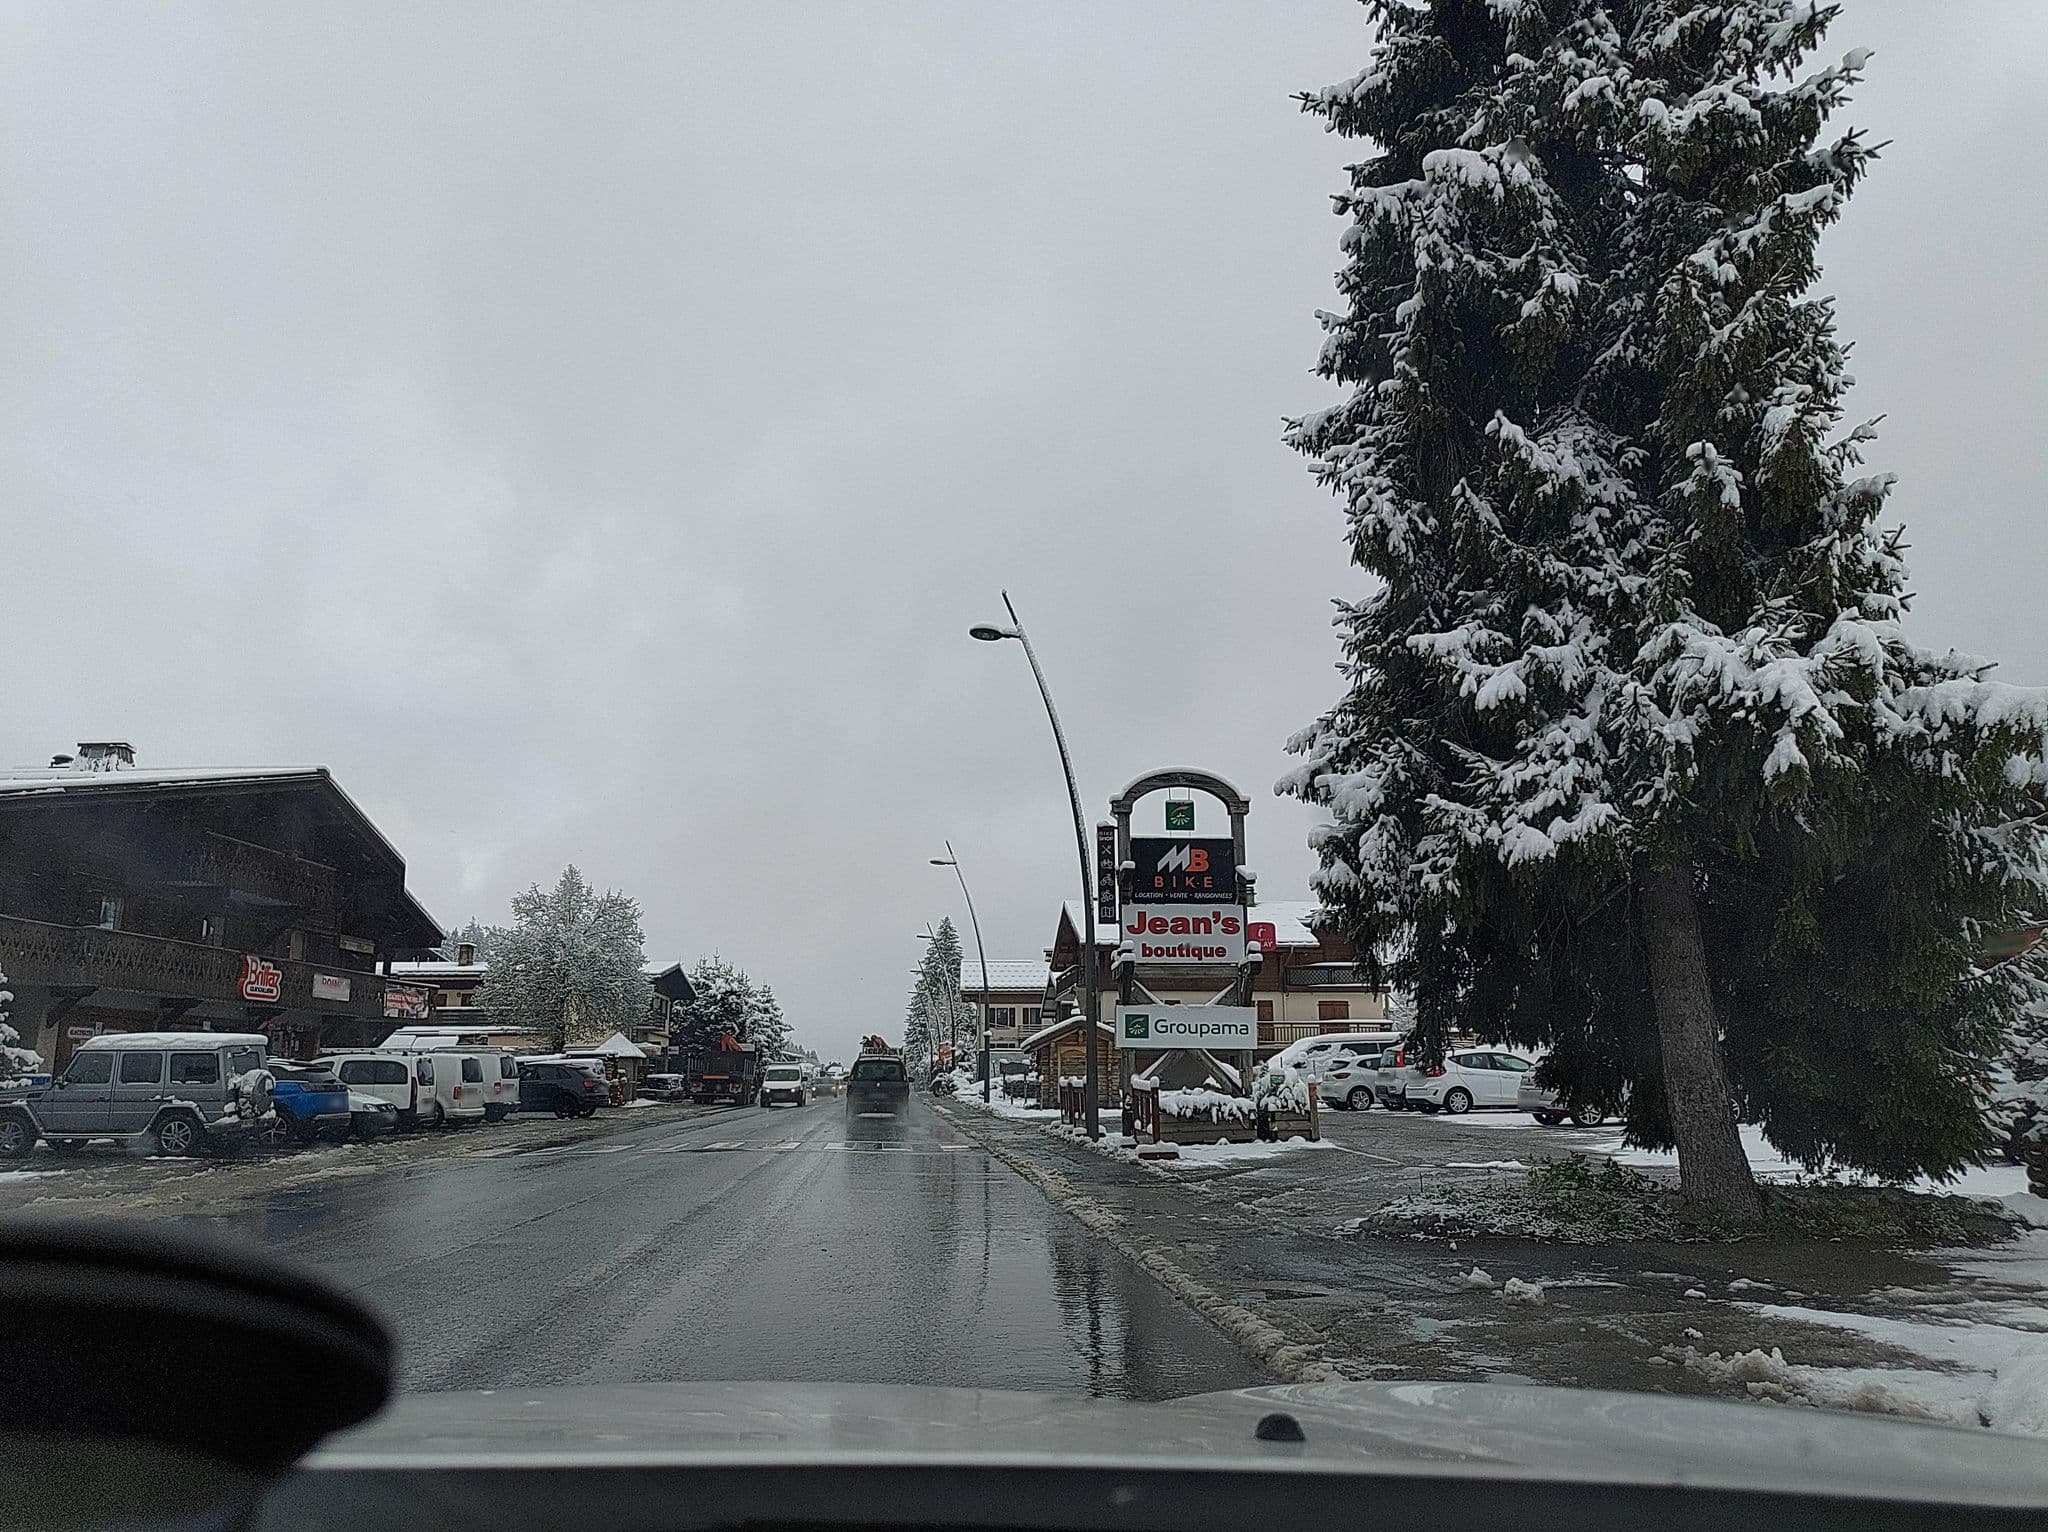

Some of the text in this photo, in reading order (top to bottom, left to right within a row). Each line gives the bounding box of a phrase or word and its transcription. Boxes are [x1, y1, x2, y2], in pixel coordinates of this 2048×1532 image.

[1157, 844, 1209, 873] MB
[1154, 875, 1213, 888] BIKE
[1126, 911, 1241, 935] Jean's
[1141, 943, 1228, 960] boutique
[1154, 1018, 1250, 1038] Groupama
